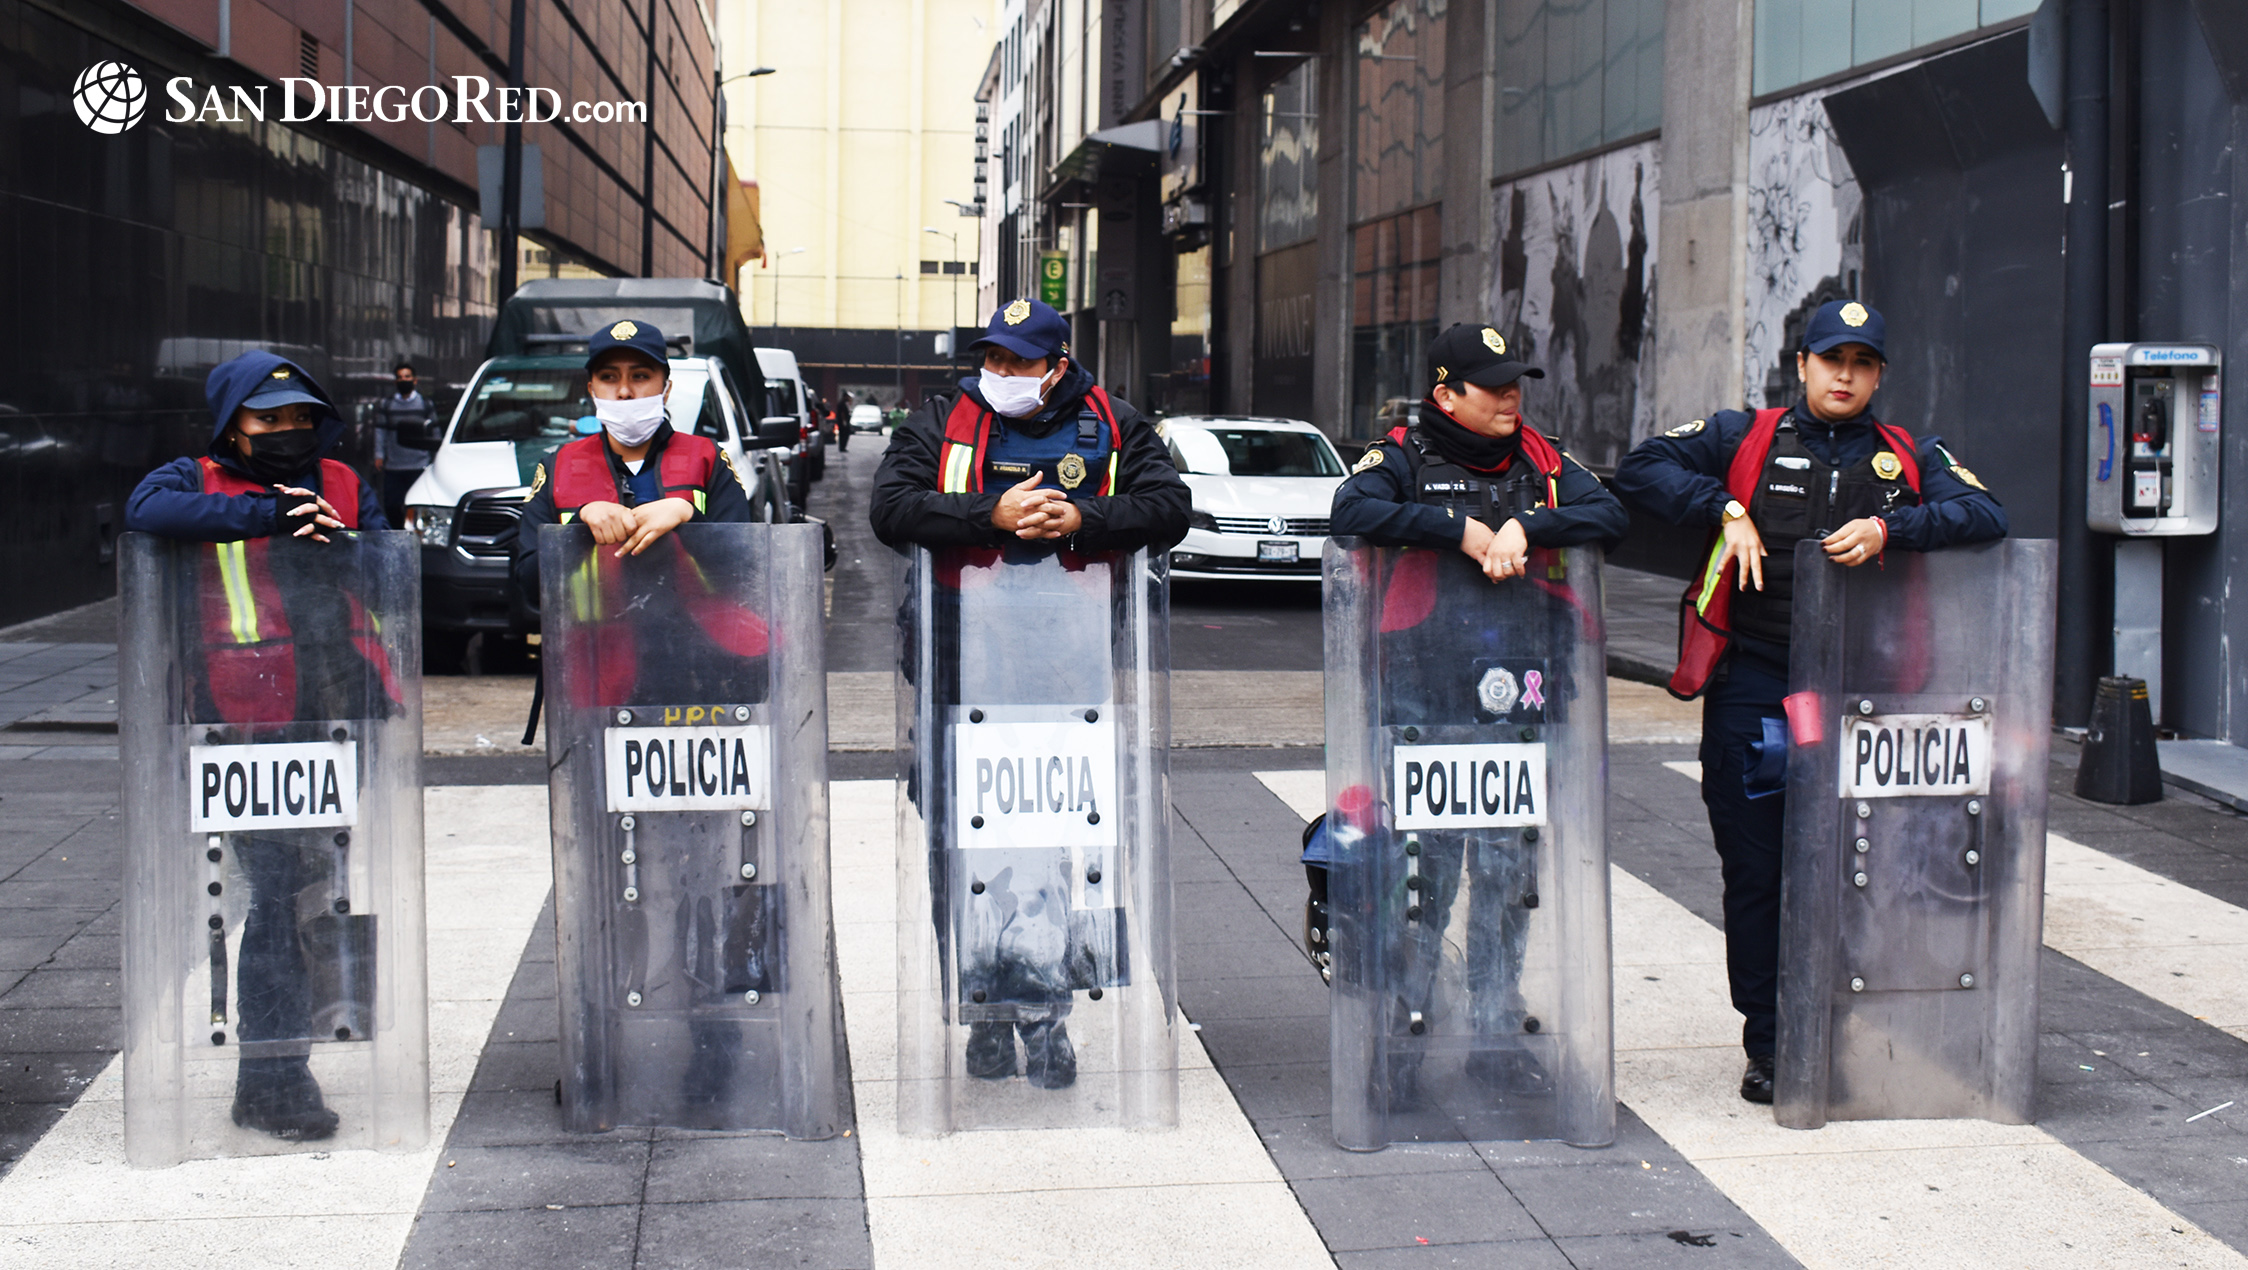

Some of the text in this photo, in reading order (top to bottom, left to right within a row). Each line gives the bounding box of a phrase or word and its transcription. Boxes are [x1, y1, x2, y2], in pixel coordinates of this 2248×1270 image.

[1050, 261, 1058, 277] E
[2143, 350, 2199, 361] Teléfono
[625, 737, 751, 798] POLICIA
[976, 756, 1097, 815] POLICIA
[1855, 727, 1970, 787] POLICIA
[202, 759, 342, 819] POLICIA
[1405, 760, 1535, 816] POLICIA
